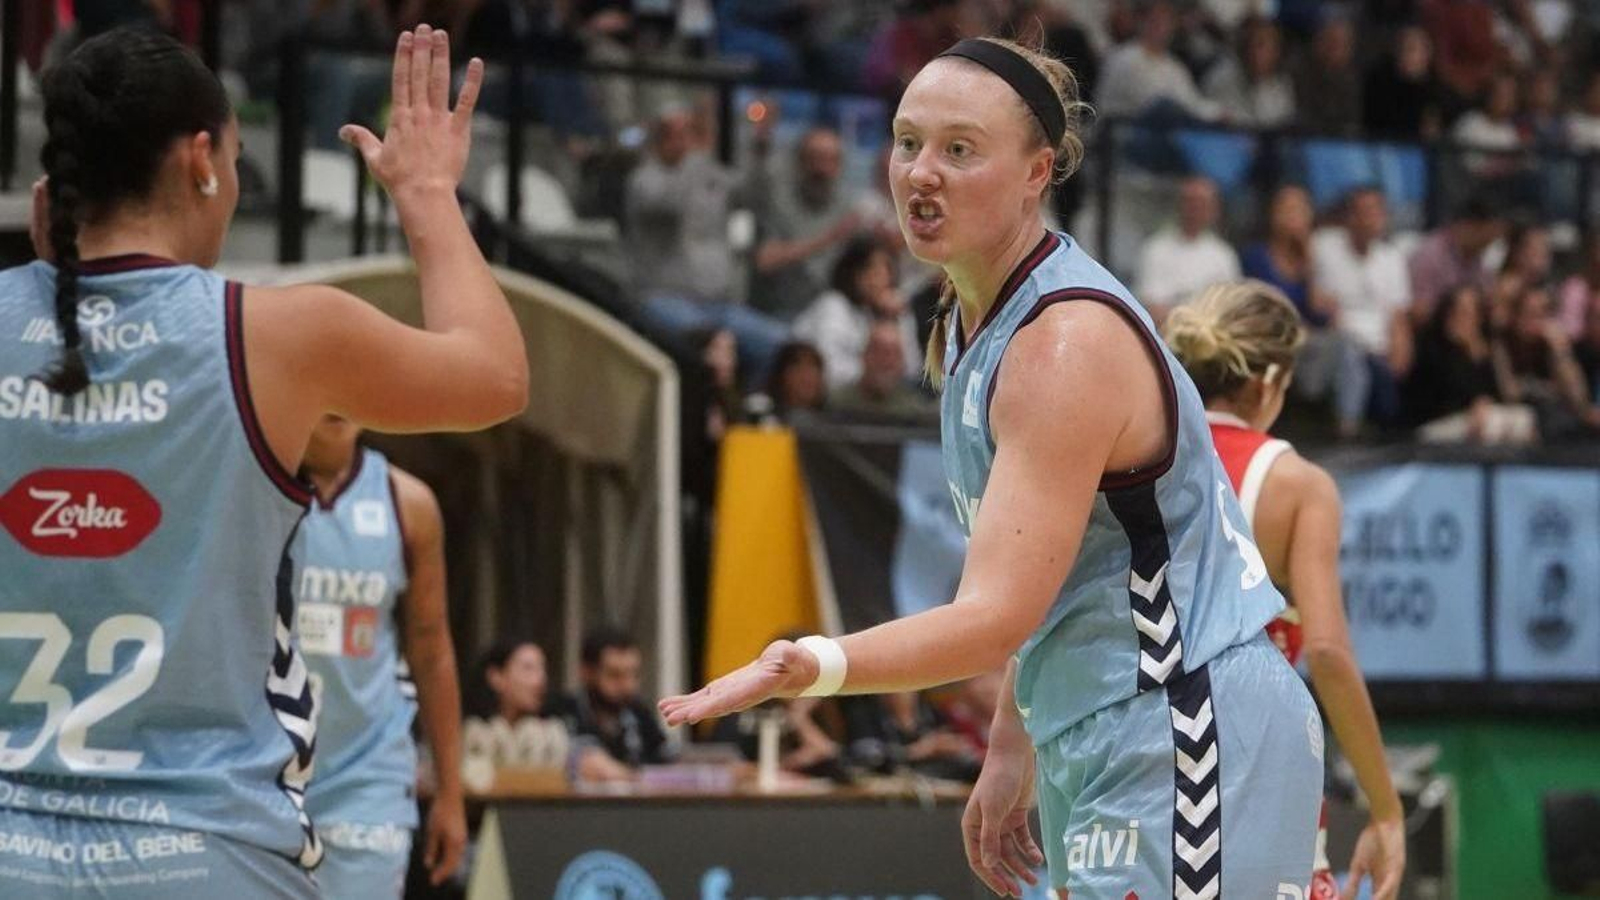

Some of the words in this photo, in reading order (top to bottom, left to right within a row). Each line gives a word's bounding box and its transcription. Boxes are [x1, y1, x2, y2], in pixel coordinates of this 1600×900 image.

[0, 376, 169, 423] SALINAS
[29, 487, 127, 539] Zorka
[0, 612, 164, 771] 32
[41, 790, 171, 824] GALICIA
[82, 840, 132, 865] DEL
[136, 831, 206, 860] BENE
[1063, 819, 1140, 871] alvi
